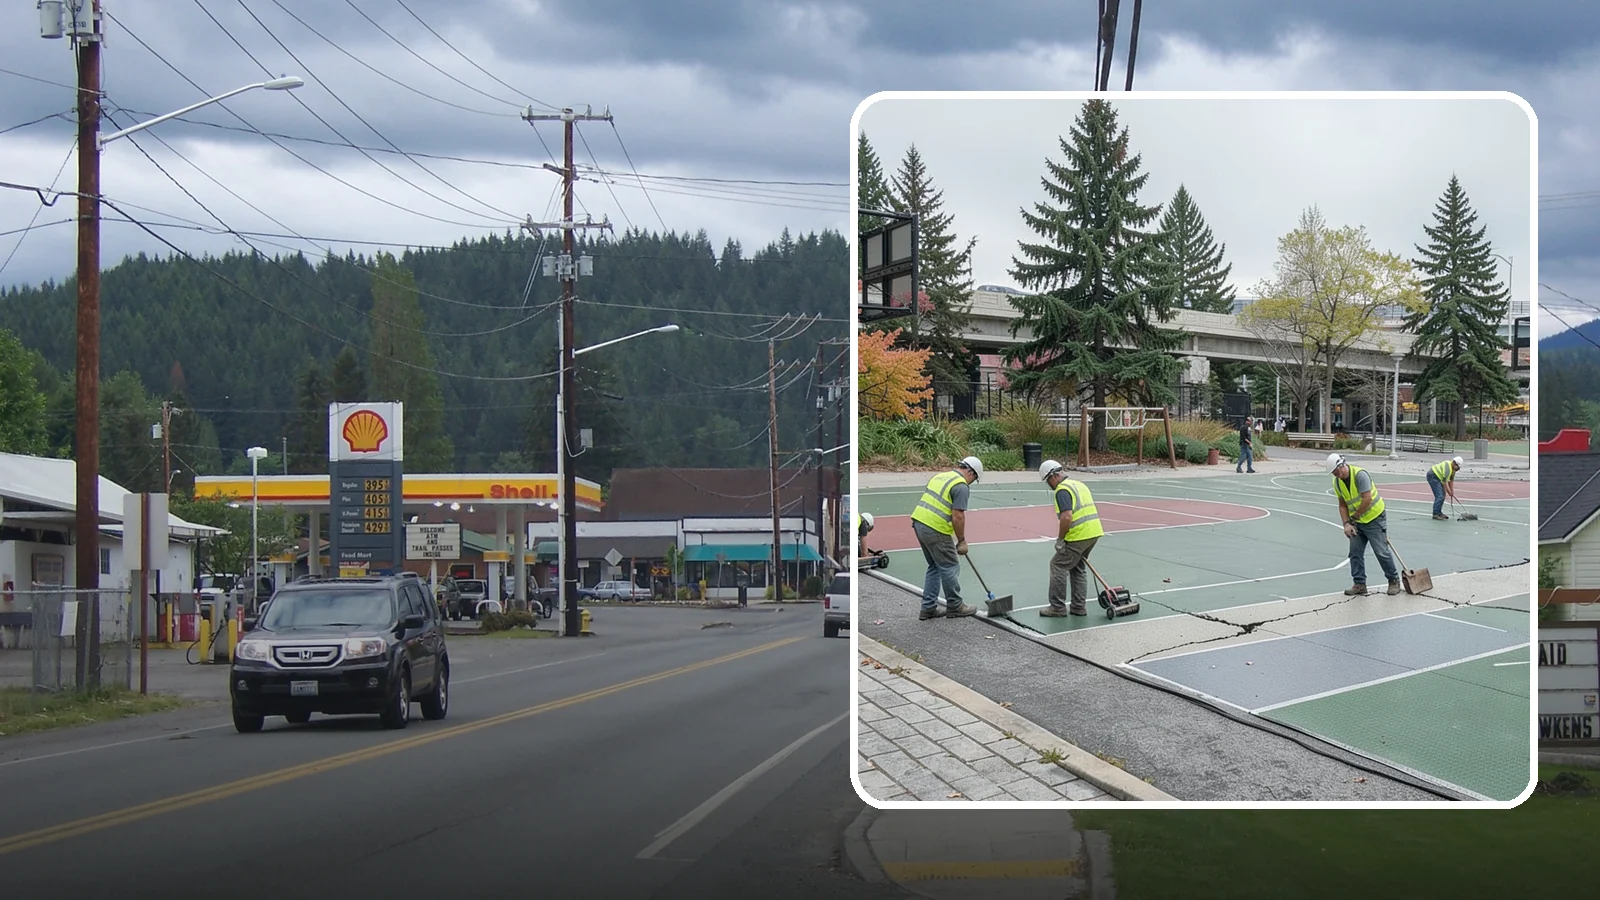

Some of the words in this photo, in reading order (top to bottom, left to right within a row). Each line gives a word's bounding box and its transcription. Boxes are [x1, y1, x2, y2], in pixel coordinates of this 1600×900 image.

[366, 480, 384, 490] 395
[490, 484, 547, 498] Shell
[365, 494, 384, 504] 405
[365, 508, 383, 518] 415
[365, 522, 384, 532] 429
